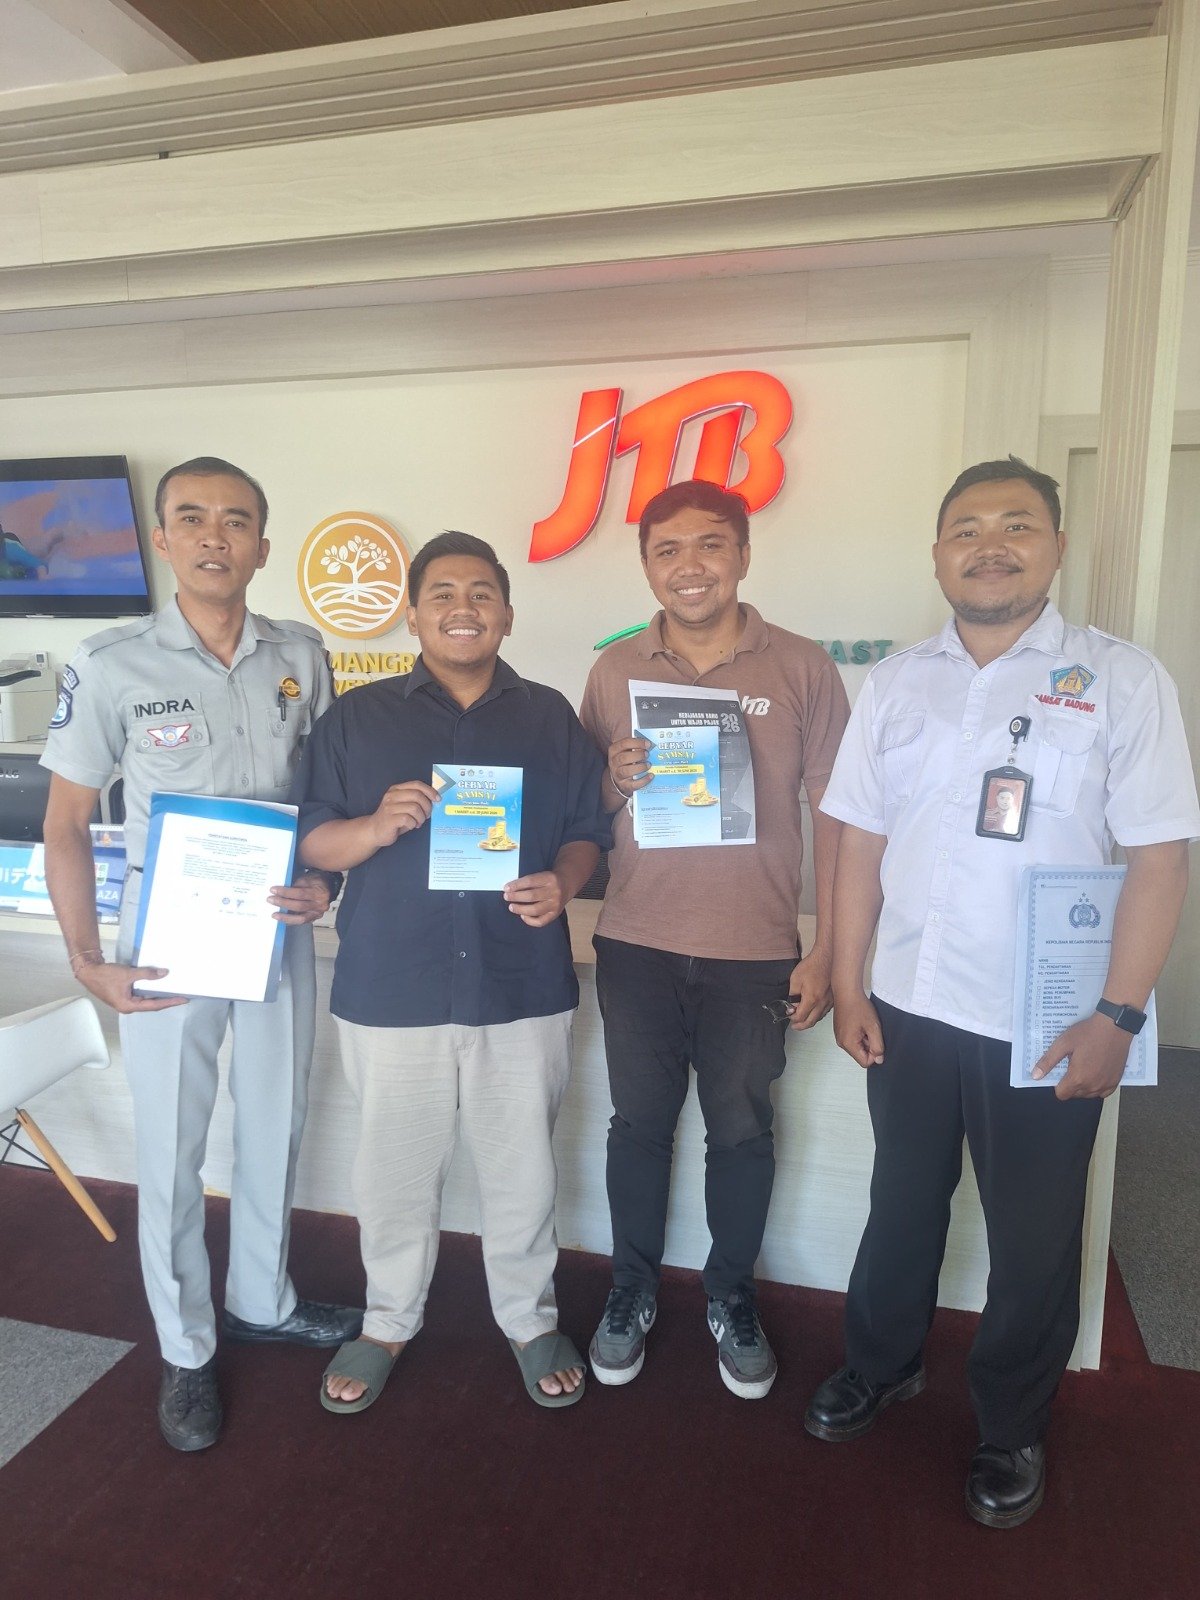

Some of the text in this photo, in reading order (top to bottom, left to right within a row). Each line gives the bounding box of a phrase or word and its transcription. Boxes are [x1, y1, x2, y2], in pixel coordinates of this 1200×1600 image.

[528, 371, 793, 563] JTB
[814, 640, 893, 665] AST
[134, 699, 195, 717] INDRA
[741, 696, 771, 716] JTB
[1064, 698, 1096, 713] BADUNG
[720, 713, 738, 723] 20
[722, 722, 740, 732] 26
[458, 780, 497, 790] GEBYAR
